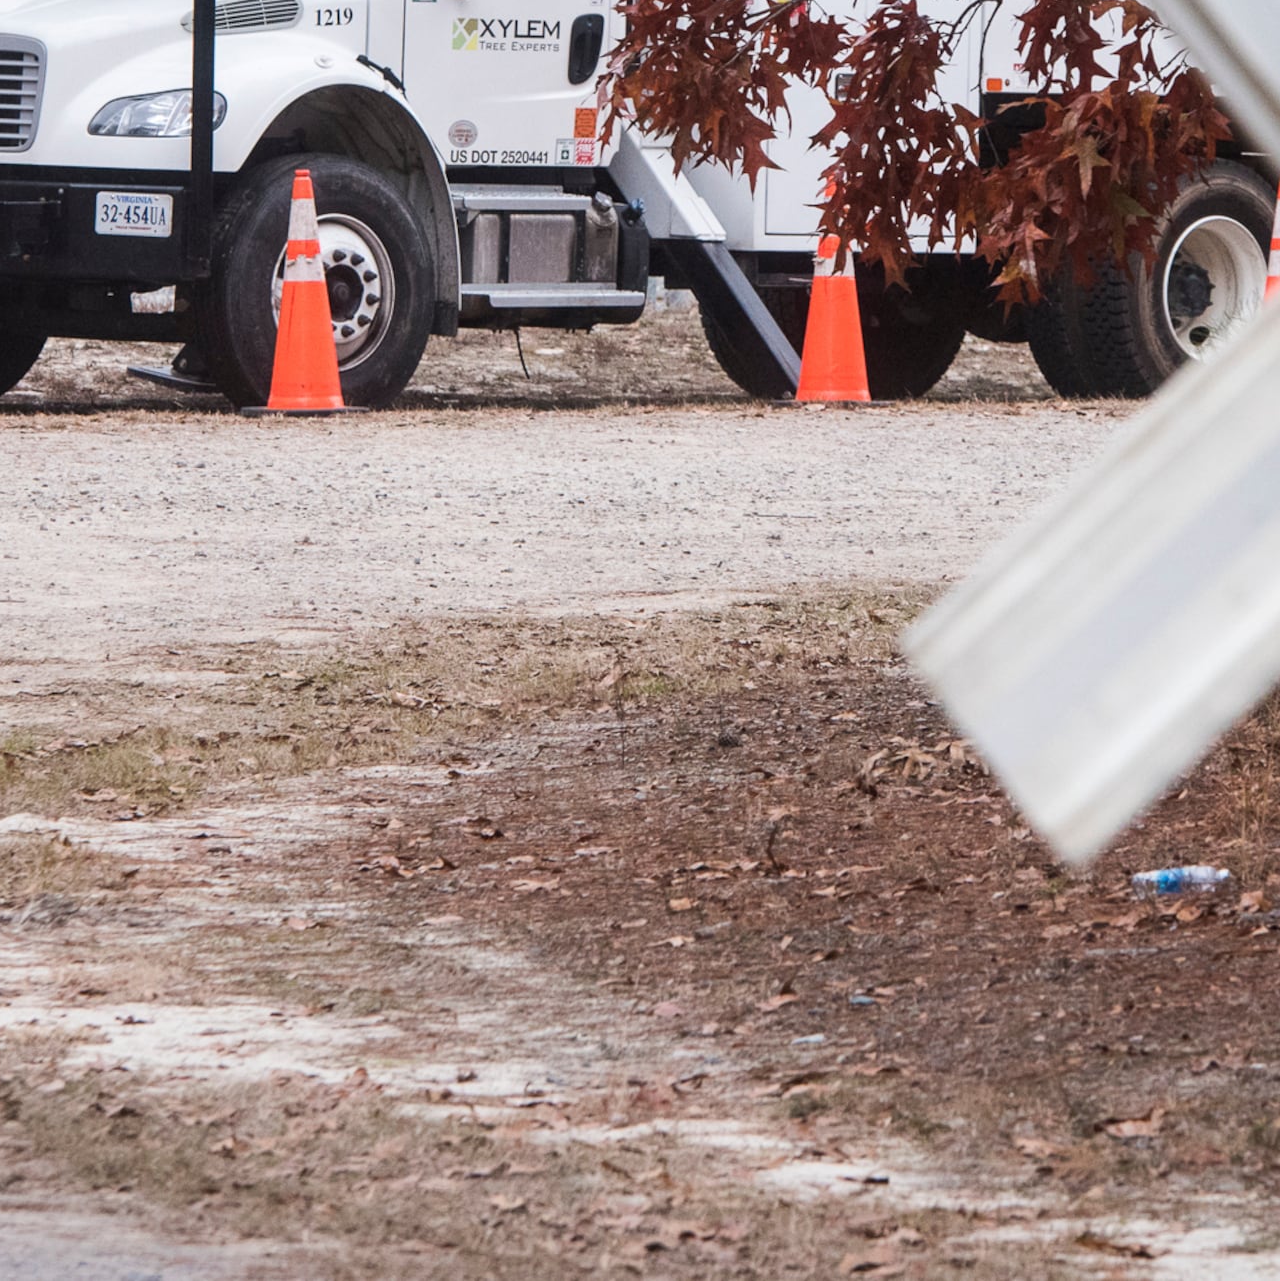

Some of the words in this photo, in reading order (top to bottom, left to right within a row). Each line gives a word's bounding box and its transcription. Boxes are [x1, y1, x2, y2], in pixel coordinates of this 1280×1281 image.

[315, 7, 353, 26] 1219
[480, 19, 560, 39] XYLEM
[450, 150, 468, 163] US
[471, 150, 498, 164] DOT
[501, 150, 549, 164] 2520441
[117, 195, 152, 204] VIRGINIA
[101, 204, 166, 226] 32-454UA
